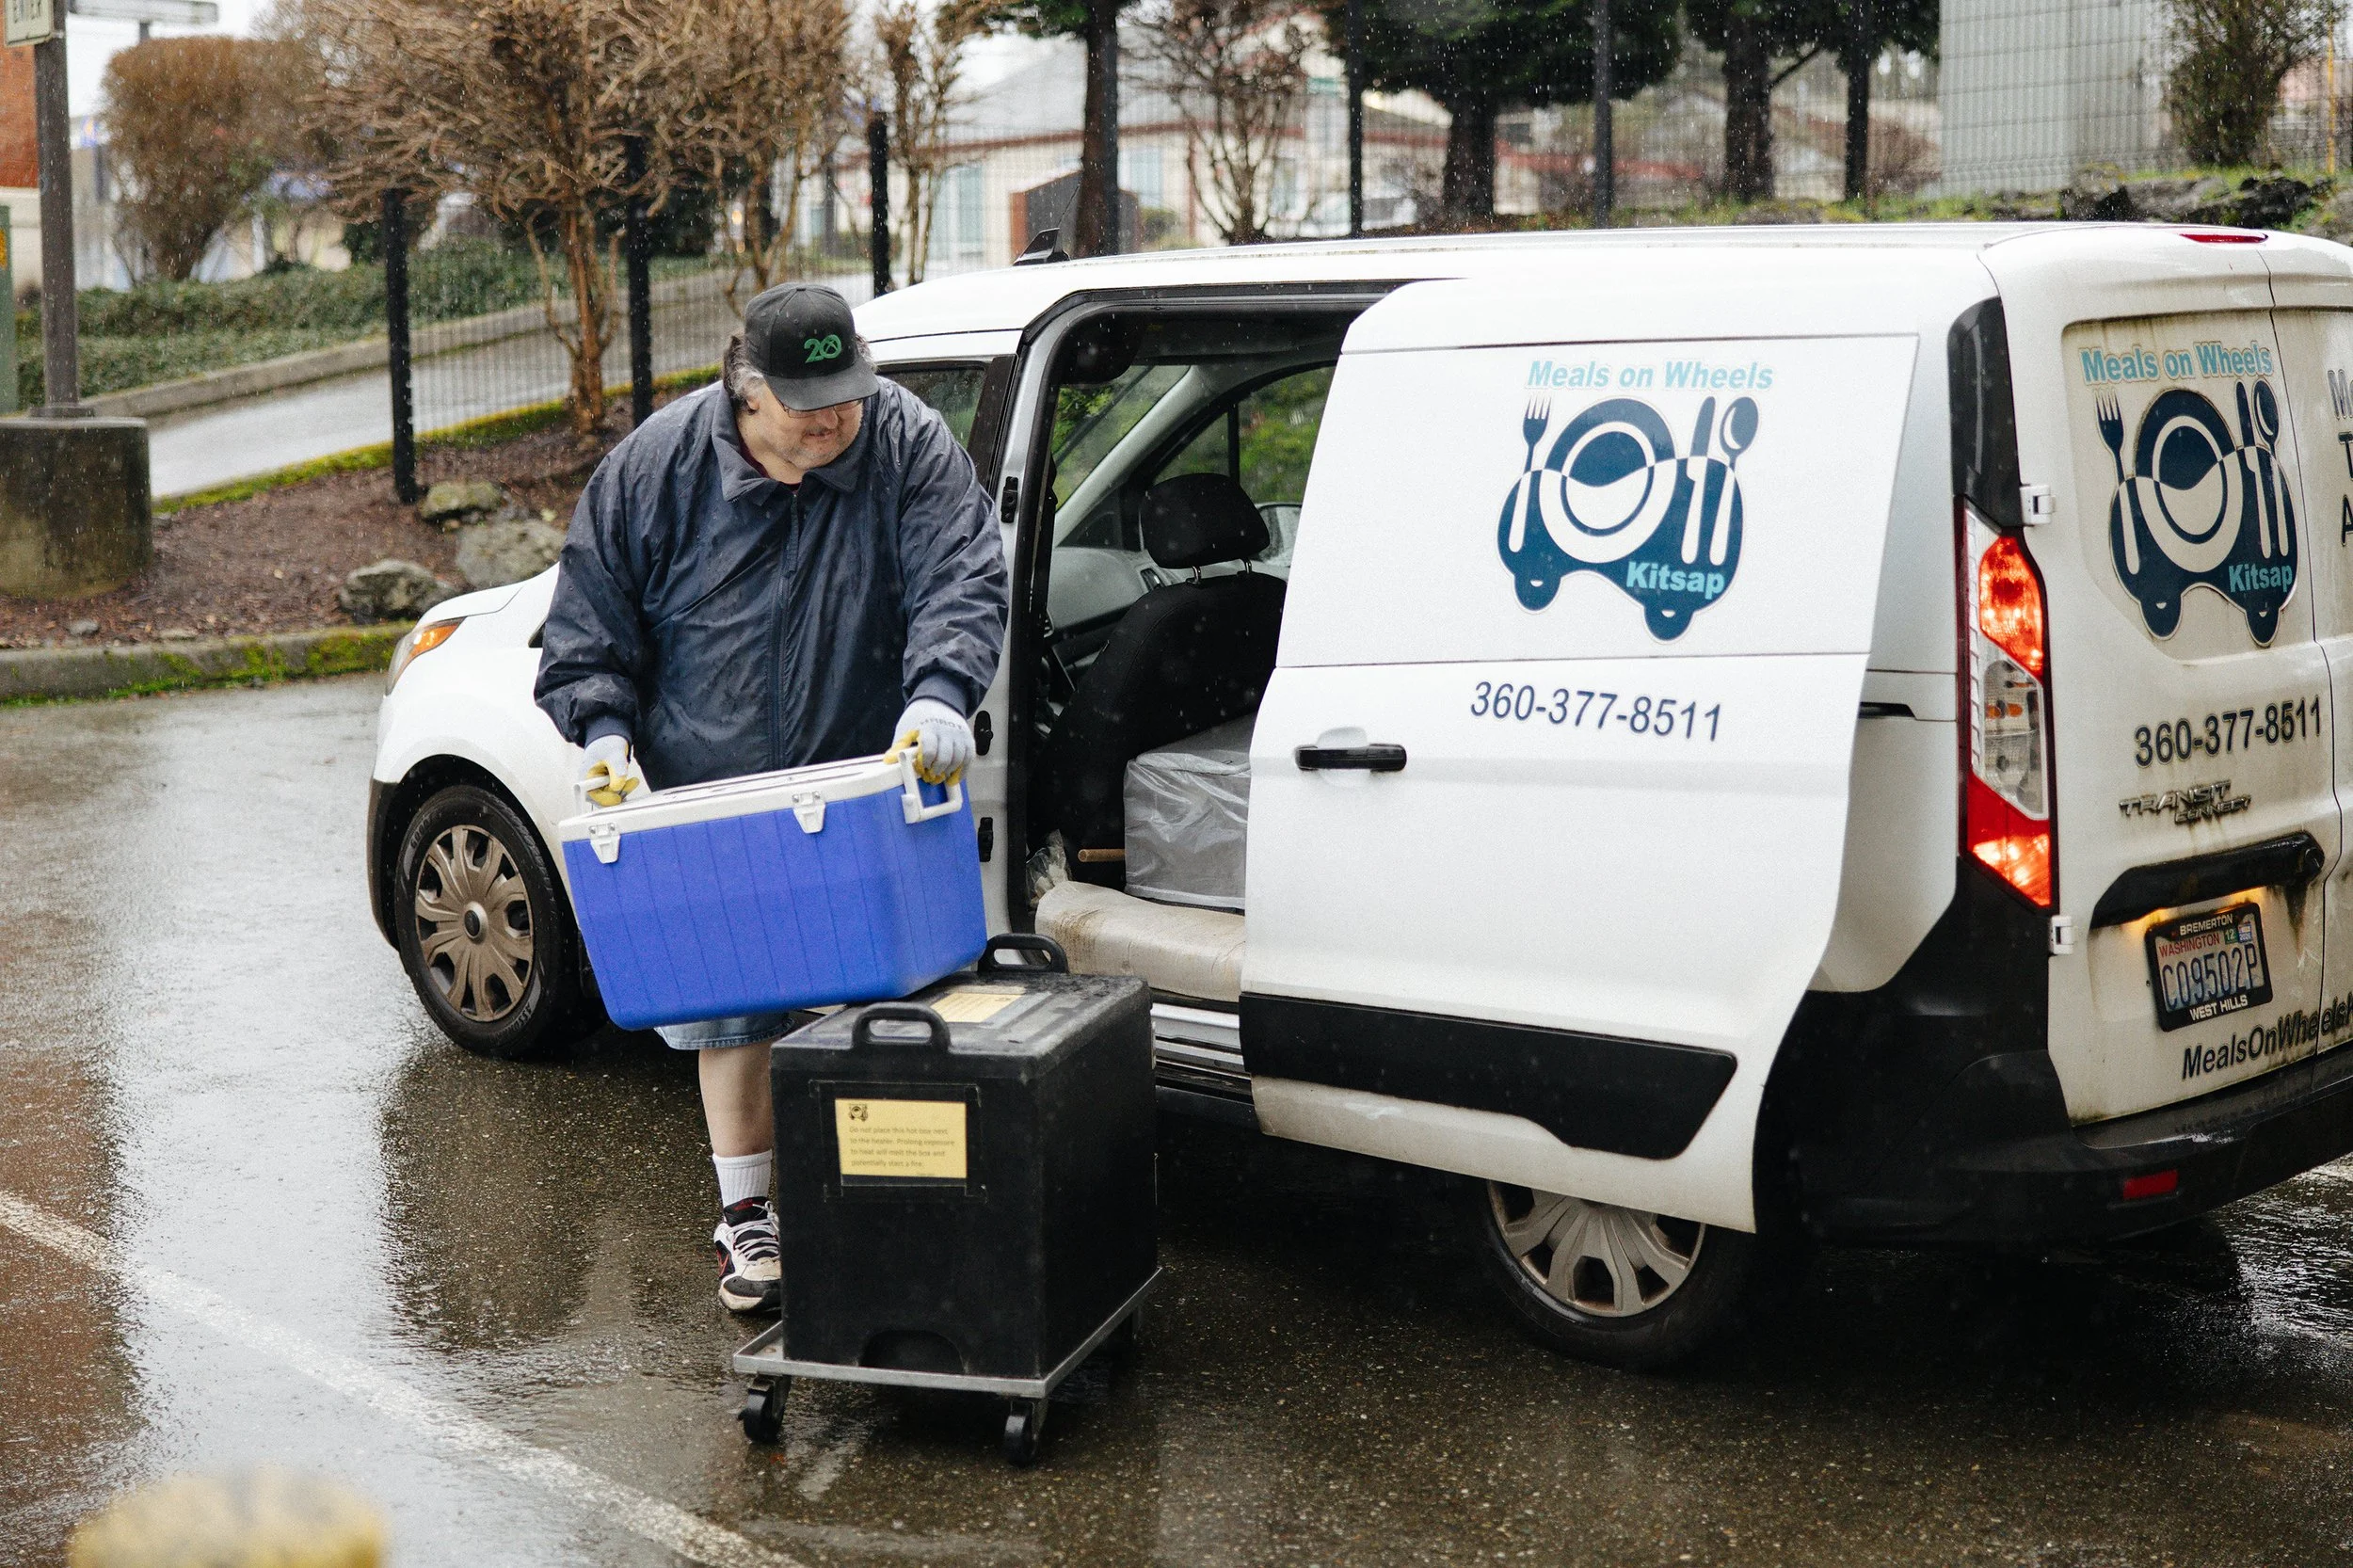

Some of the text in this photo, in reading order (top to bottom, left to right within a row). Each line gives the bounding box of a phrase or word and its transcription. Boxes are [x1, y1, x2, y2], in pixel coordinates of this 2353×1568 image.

[1528, 360, 1773, 390] Meals on Wheels
[2080, 341, 2273, 383] Meals on Wheels
[1626, 562, 1725, 600] Kitsap
[2228, 564, 2294, 594] Kitsap
[1470, 681, 1721, 742] 360-377-8511
[2135, 695, 2321, 769] 360-377-8511
[2119, 779, 2232, 816] TRANSIT
[2174, 794, 2251, 824] CONNECT
[2179, 913, 2233, 936] BREMERTON
[2159, 928, 2235, 958] WASHINGTON 12
[2162, 943, 2258, 1009] C09502P
[2189, 994, 2249, 1021] WEST HILLS
